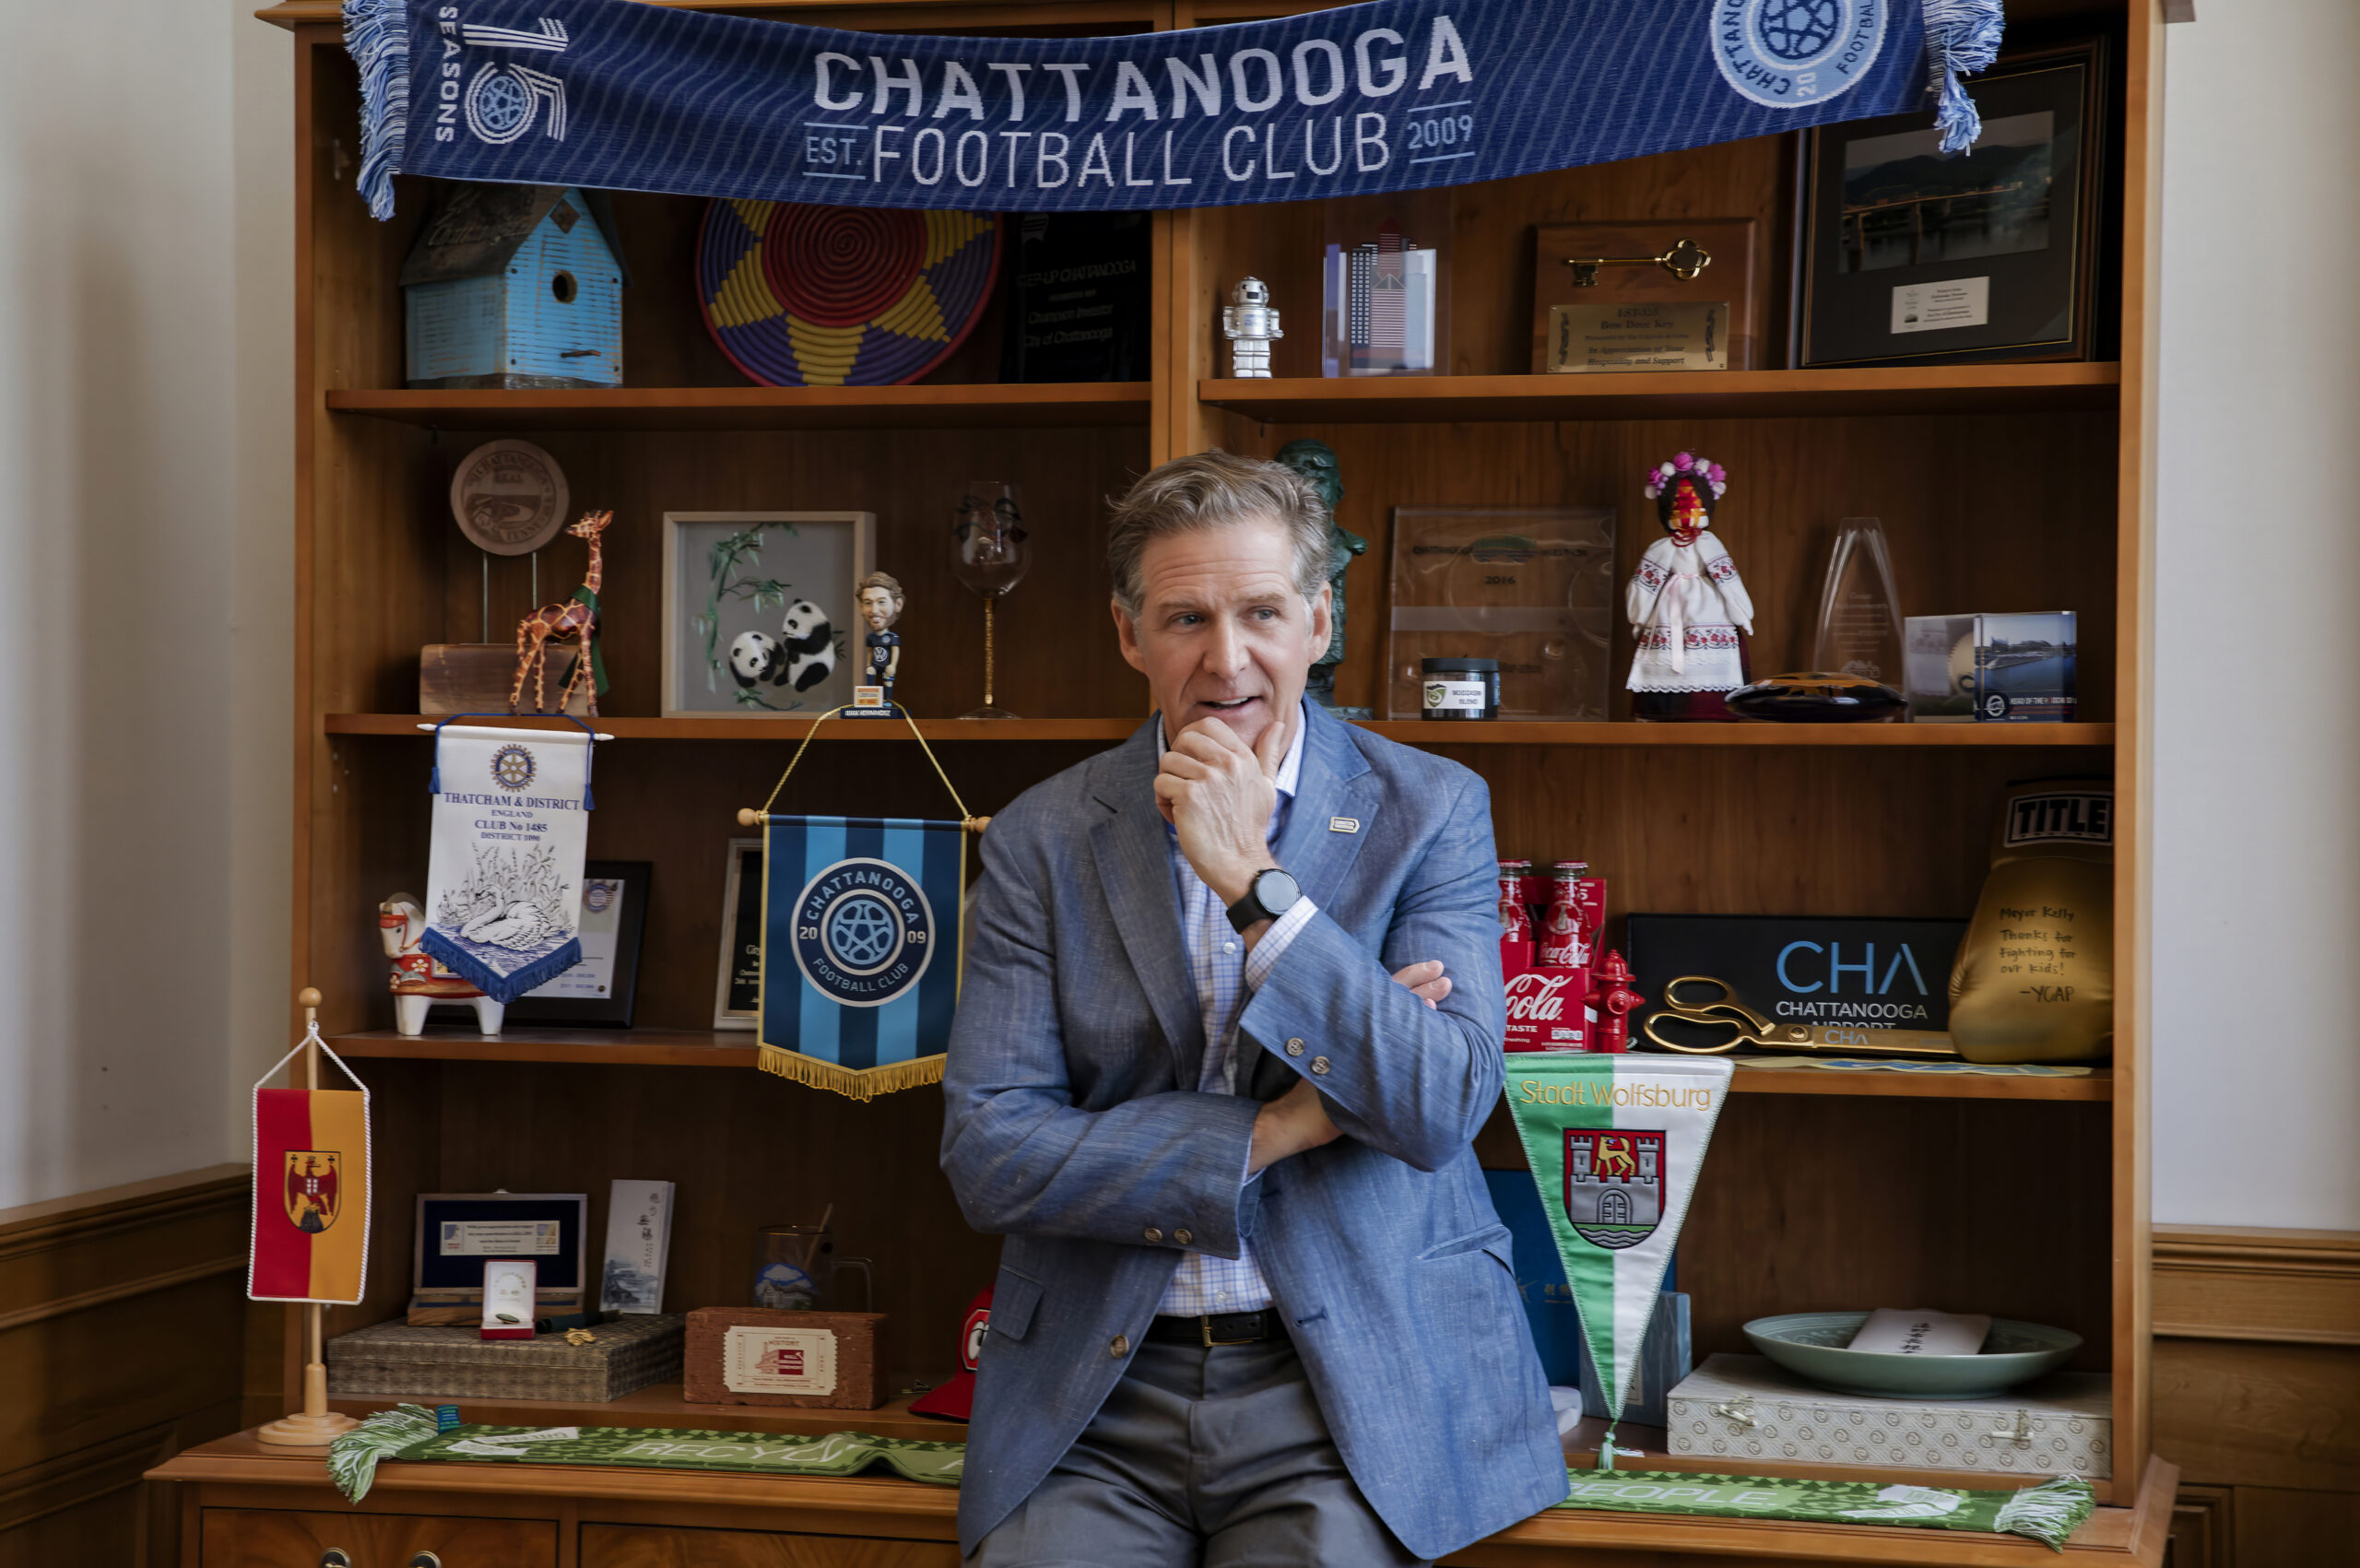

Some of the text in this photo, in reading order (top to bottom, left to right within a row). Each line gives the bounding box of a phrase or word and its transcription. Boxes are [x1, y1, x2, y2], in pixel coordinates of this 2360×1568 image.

[435, 6, 461, 142] SEASONS
[813, 15, 1473, 123] CHATTANOOGA
[1408, 115, 1473, 149] 2009
[804, 136, 863, 166] EST.
[873, 112, 1390, 188] FOOTBALL CLUB
[1483, 575, 1516, 585] 2016
[443, 792, 580, 811] THATCHAM & DISTRICT
[490, 809, 534, 819] ENGLAND
[475, 819, 506, 831] CLUB
[2017, 797, 2108, 835] TITLE
[480, 831, 522, 841] DISTRICT
[806, 870, 919, 924] CHATTANOOGA
[799, 926, 818, 939] 20
[907, 930, 926, 944] 09
[812, 958, 909, 992] FOOTBALL CLUB
[1776, 940, 1929, 996] CHA
[1776, 1000, 1928, 1020] CHATTANOOGA
[1505, 1024, 1538, 1032] TASTE
[1824, 1030, 1868, 1044] CHA
[1520, 1080, 1712, 1112] Stadt Wolfsburg
